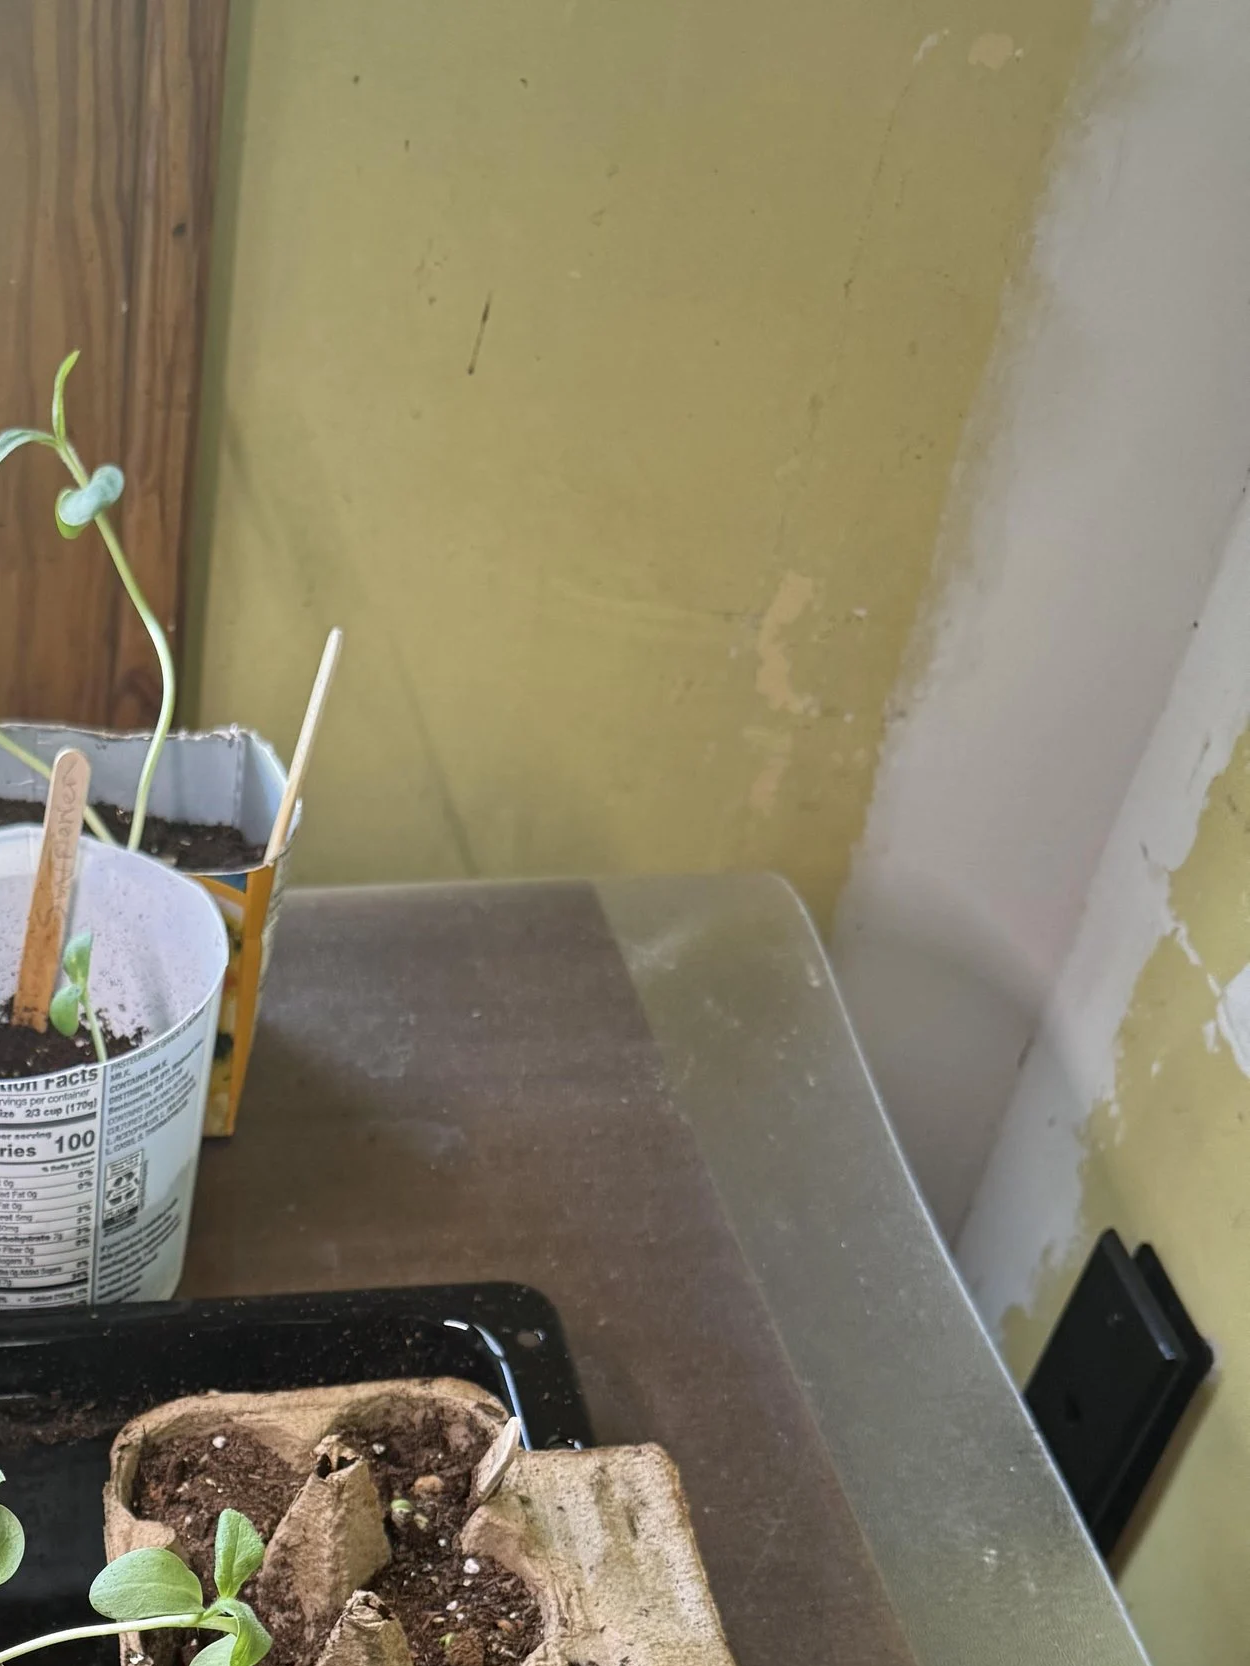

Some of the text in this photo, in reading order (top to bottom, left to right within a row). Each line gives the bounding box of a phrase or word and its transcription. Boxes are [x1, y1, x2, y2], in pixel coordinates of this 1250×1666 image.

[44, 1067, 98, 1090] Facts
[30, 1096, 46, 1108] per
[48, 1088, 91, 1103] container
[25, 1108, 41, 1119] 2/3
[43, 1106, 63, 1118] cup
[65, 1098, 98, 1115] (170g)
[14, 1130, 52, 1141] serving
[55, 1129, 96, 1154] 100
[3, 1179, 14, 1188] 0g
[12, 1190, 25, 1199] Fat
[27, 1190, 38, 1200] 0g
[11, 1202, 23, 1211] 0g
